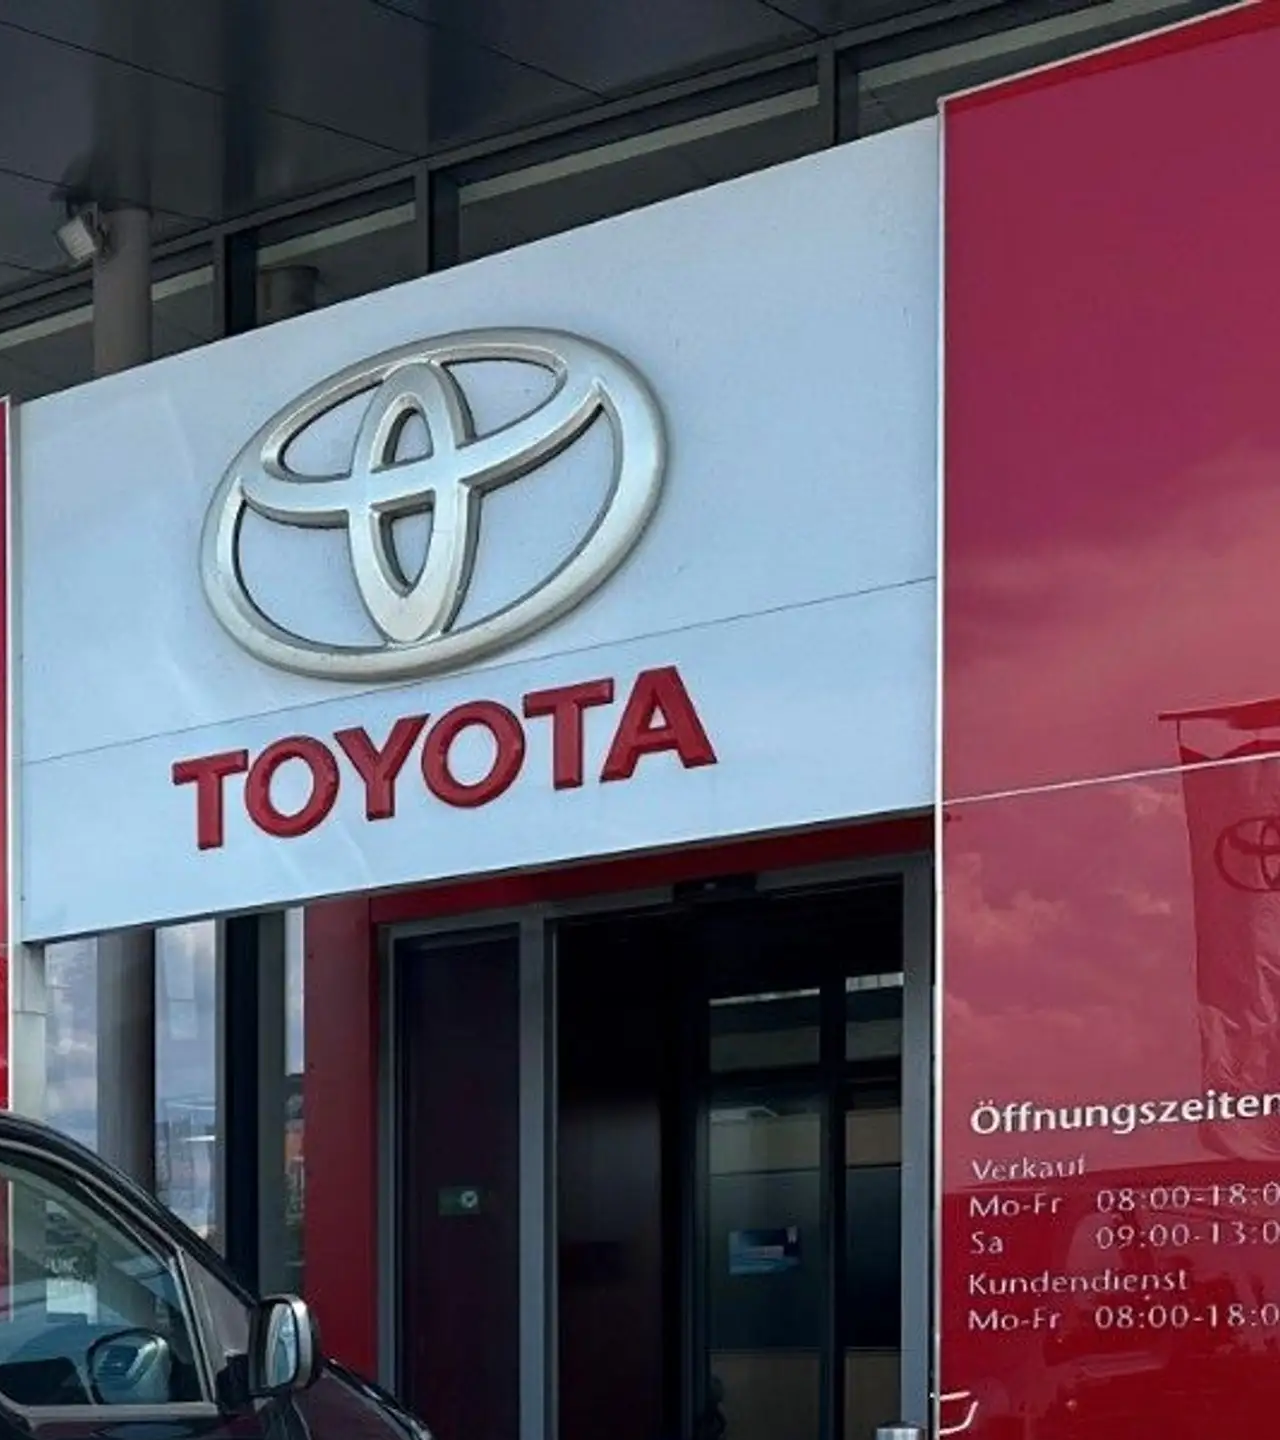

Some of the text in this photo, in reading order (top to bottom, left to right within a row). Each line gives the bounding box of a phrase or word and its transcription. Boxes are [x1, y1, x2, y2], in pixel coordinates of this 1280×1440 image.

[172, 665, 718, 850] TOYOTA
[970, 1089, 1280, 1135] Öffnungszeiten
[972, 1154, 1086, 1181] Verkauf
[969, 1193, 1062, 1219] Mo-Fr
[970, 1230, 1004, 1255] Sa
[968, 1269, 1189, 1296] Kundendienst
[968, 1309, 1062, 1331] Mo-Fr
